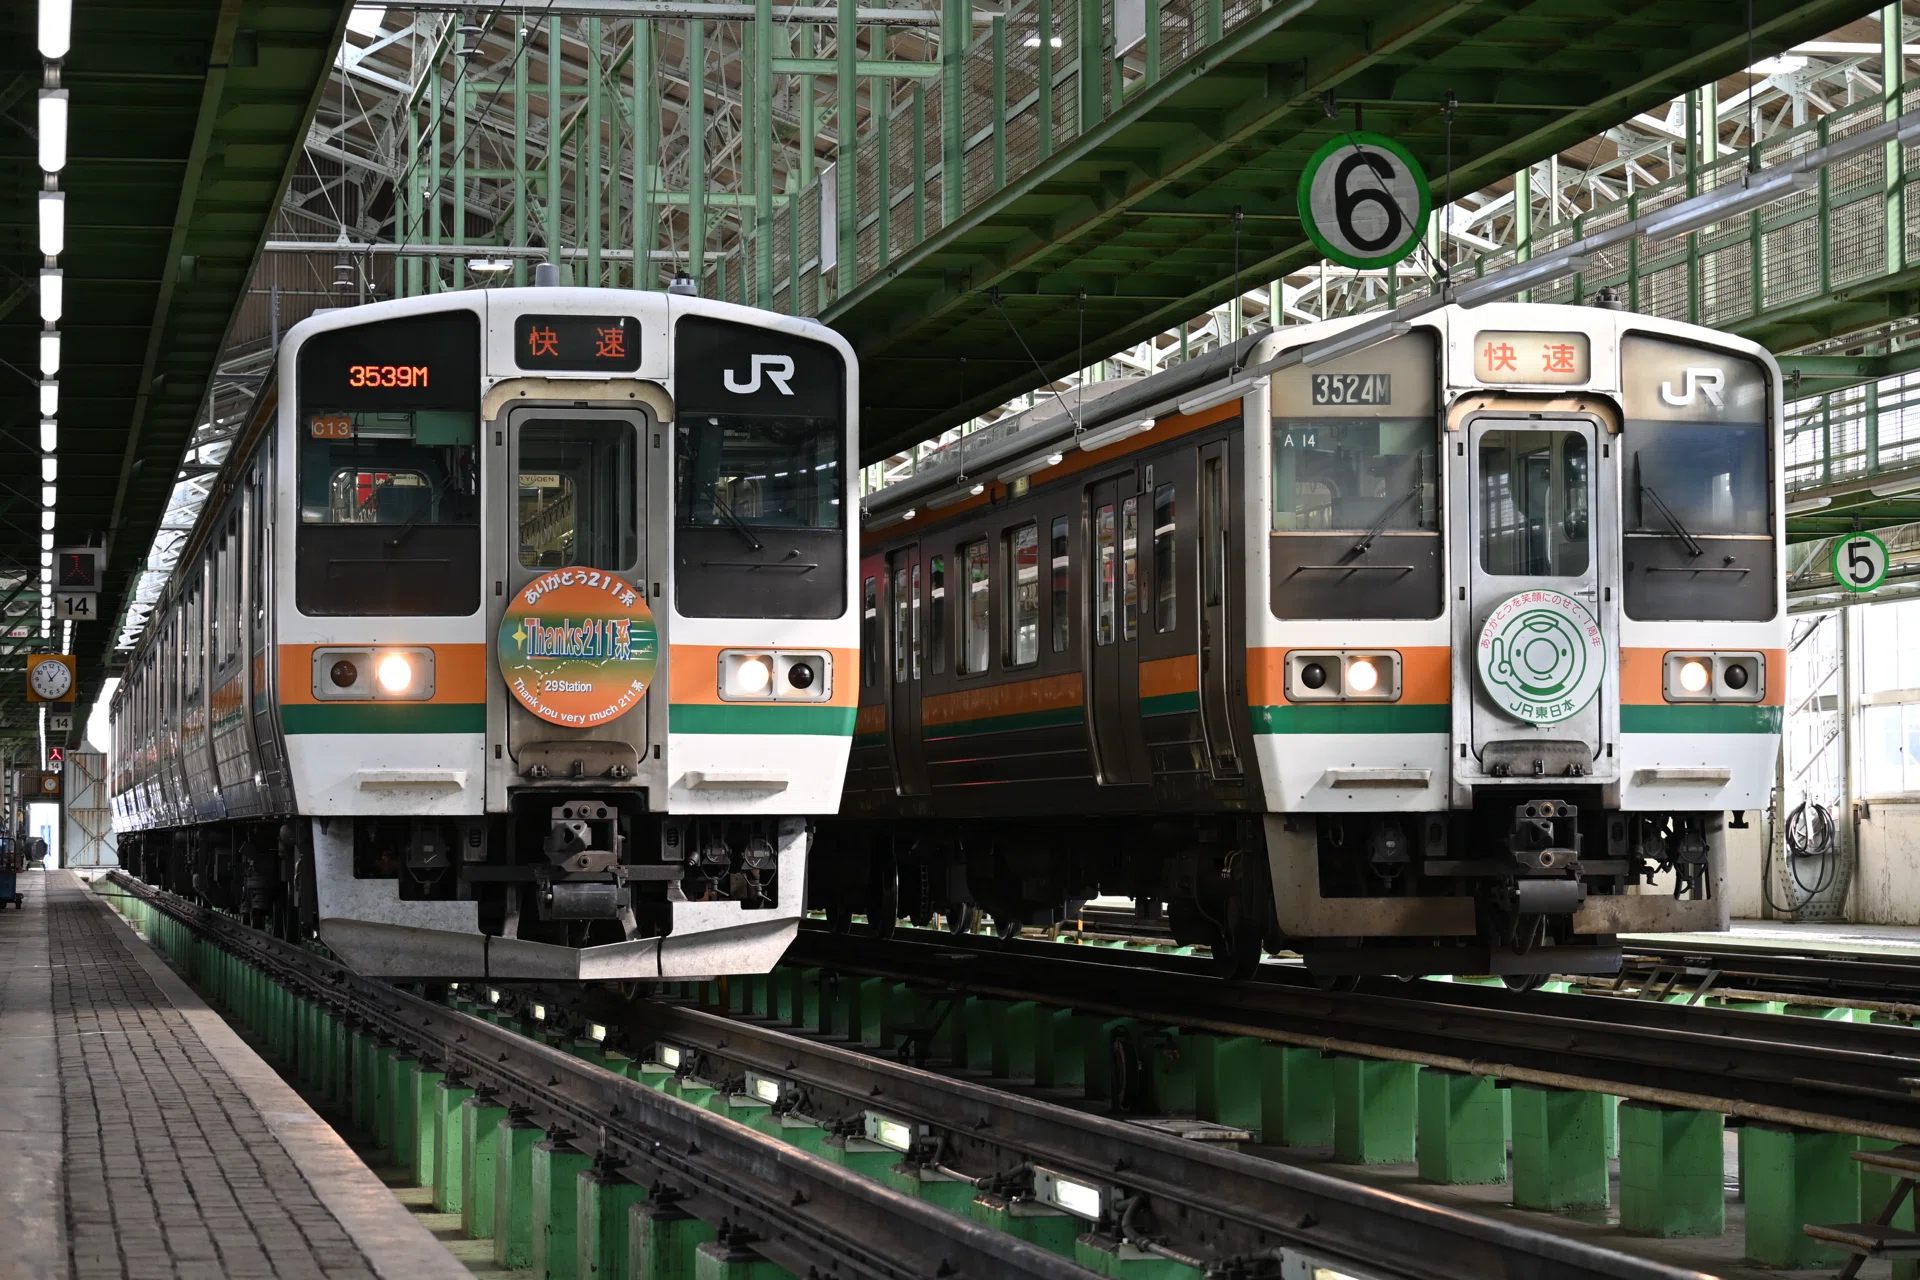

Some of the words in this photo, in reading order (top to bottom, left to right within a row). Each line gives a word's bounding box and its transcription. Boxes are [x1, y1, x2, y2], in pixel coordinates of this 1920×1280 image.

[1335, 152, 1402, 252] 6
[529, 325, 626, 358] 快速
[1484, 341, 1576, 373] 快速
[349, 365, 428, 387] 3539M
[723, 353, 795, 395] JR
[1316, 374, 1389, 403] 3524M
[1661, 367, 1726, 407] JR
[313, 422, 349, 435] C13
[1848, 541, 1875, 584] 5
[524, 570, 638, 608] ありがとう211系
[64, 597, 89, 615] 14
[524, 617, 632, 661] Thanks211系
[514, 677, 539, 708] Thank
[537, 703, 559, 719] you
[561, 713, 586, 724] very
[589, 703, 619, 722] much
[545, 680, 593, 693] 29Station
[55, 718, 68, 728] 14
[1509, 699, 1576, 720] JR東日本
